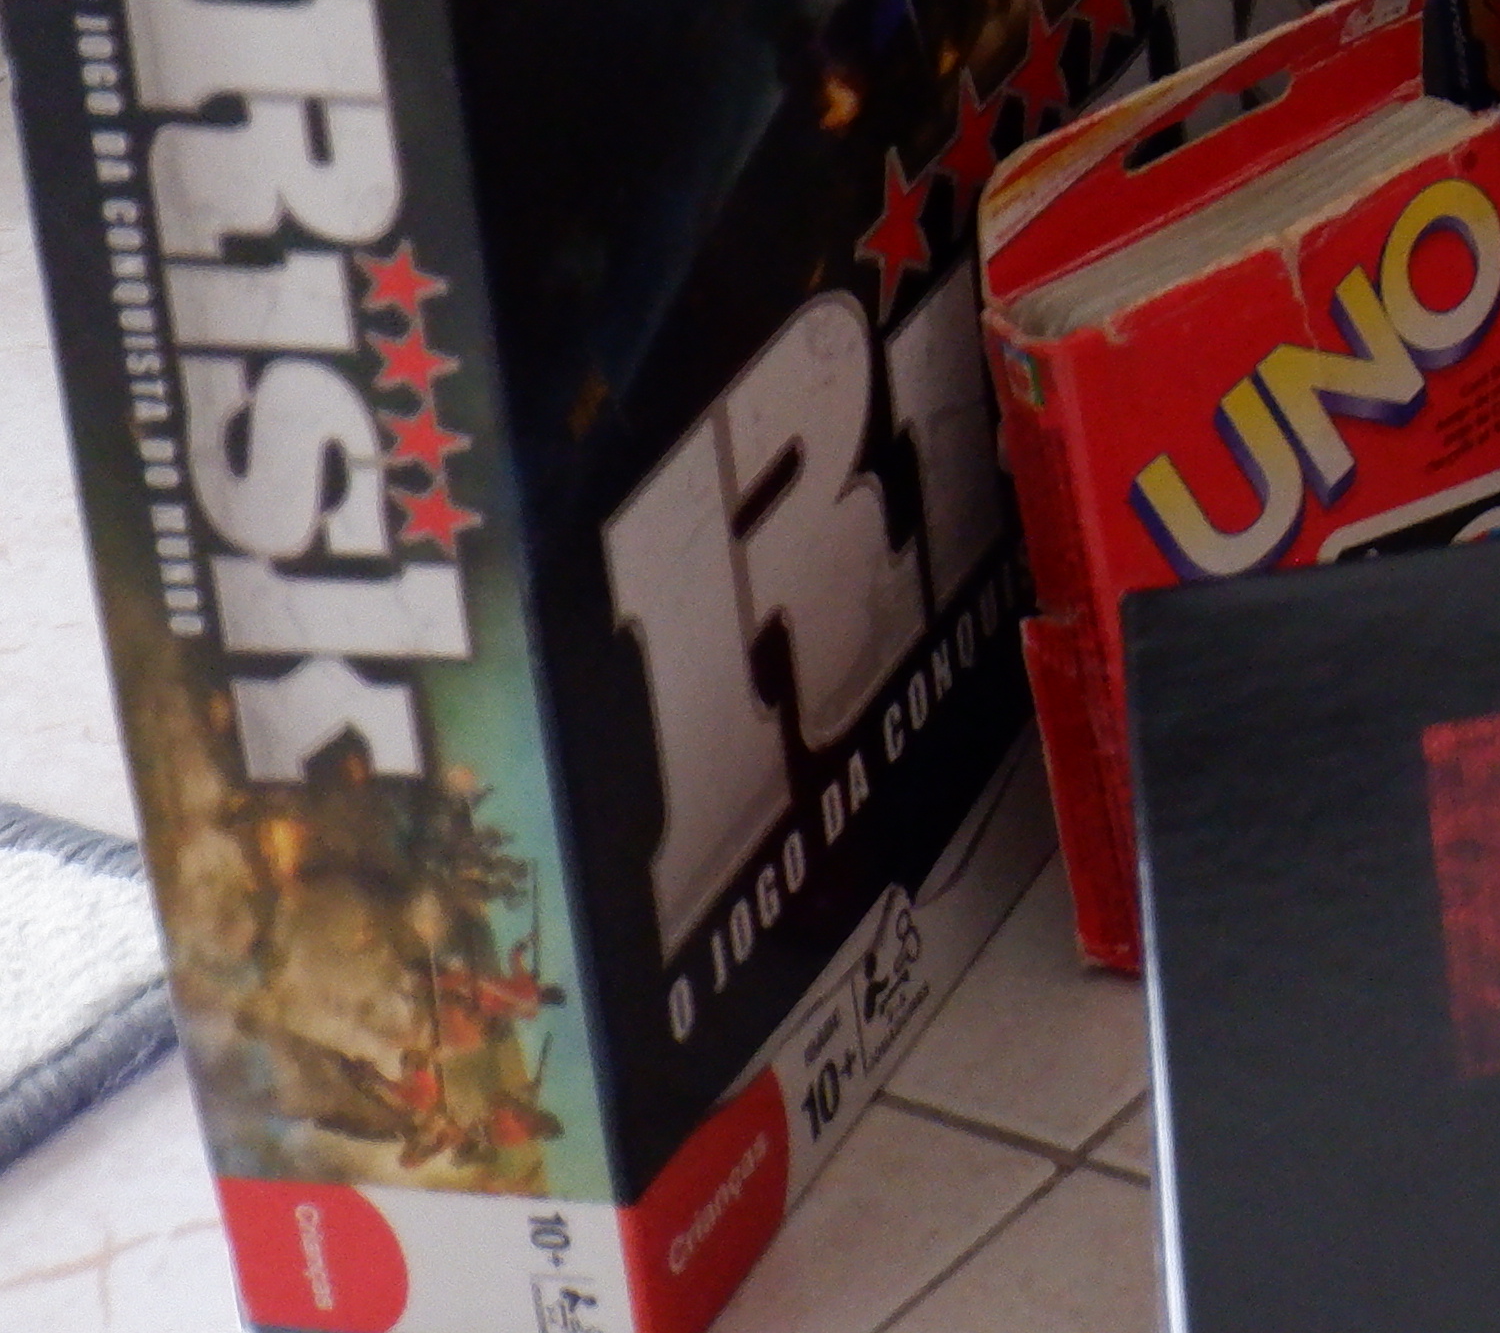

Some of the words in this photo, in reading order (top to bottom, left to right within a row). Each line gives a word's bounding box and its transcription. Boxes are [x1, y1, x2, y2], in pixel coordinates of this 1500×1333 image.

[666, 972, 698, 1044] O
[710, 833, 808, 995] JOGO
[820, 763, 872, 847] DA
[800, 1048, 857, 1144] 10+
